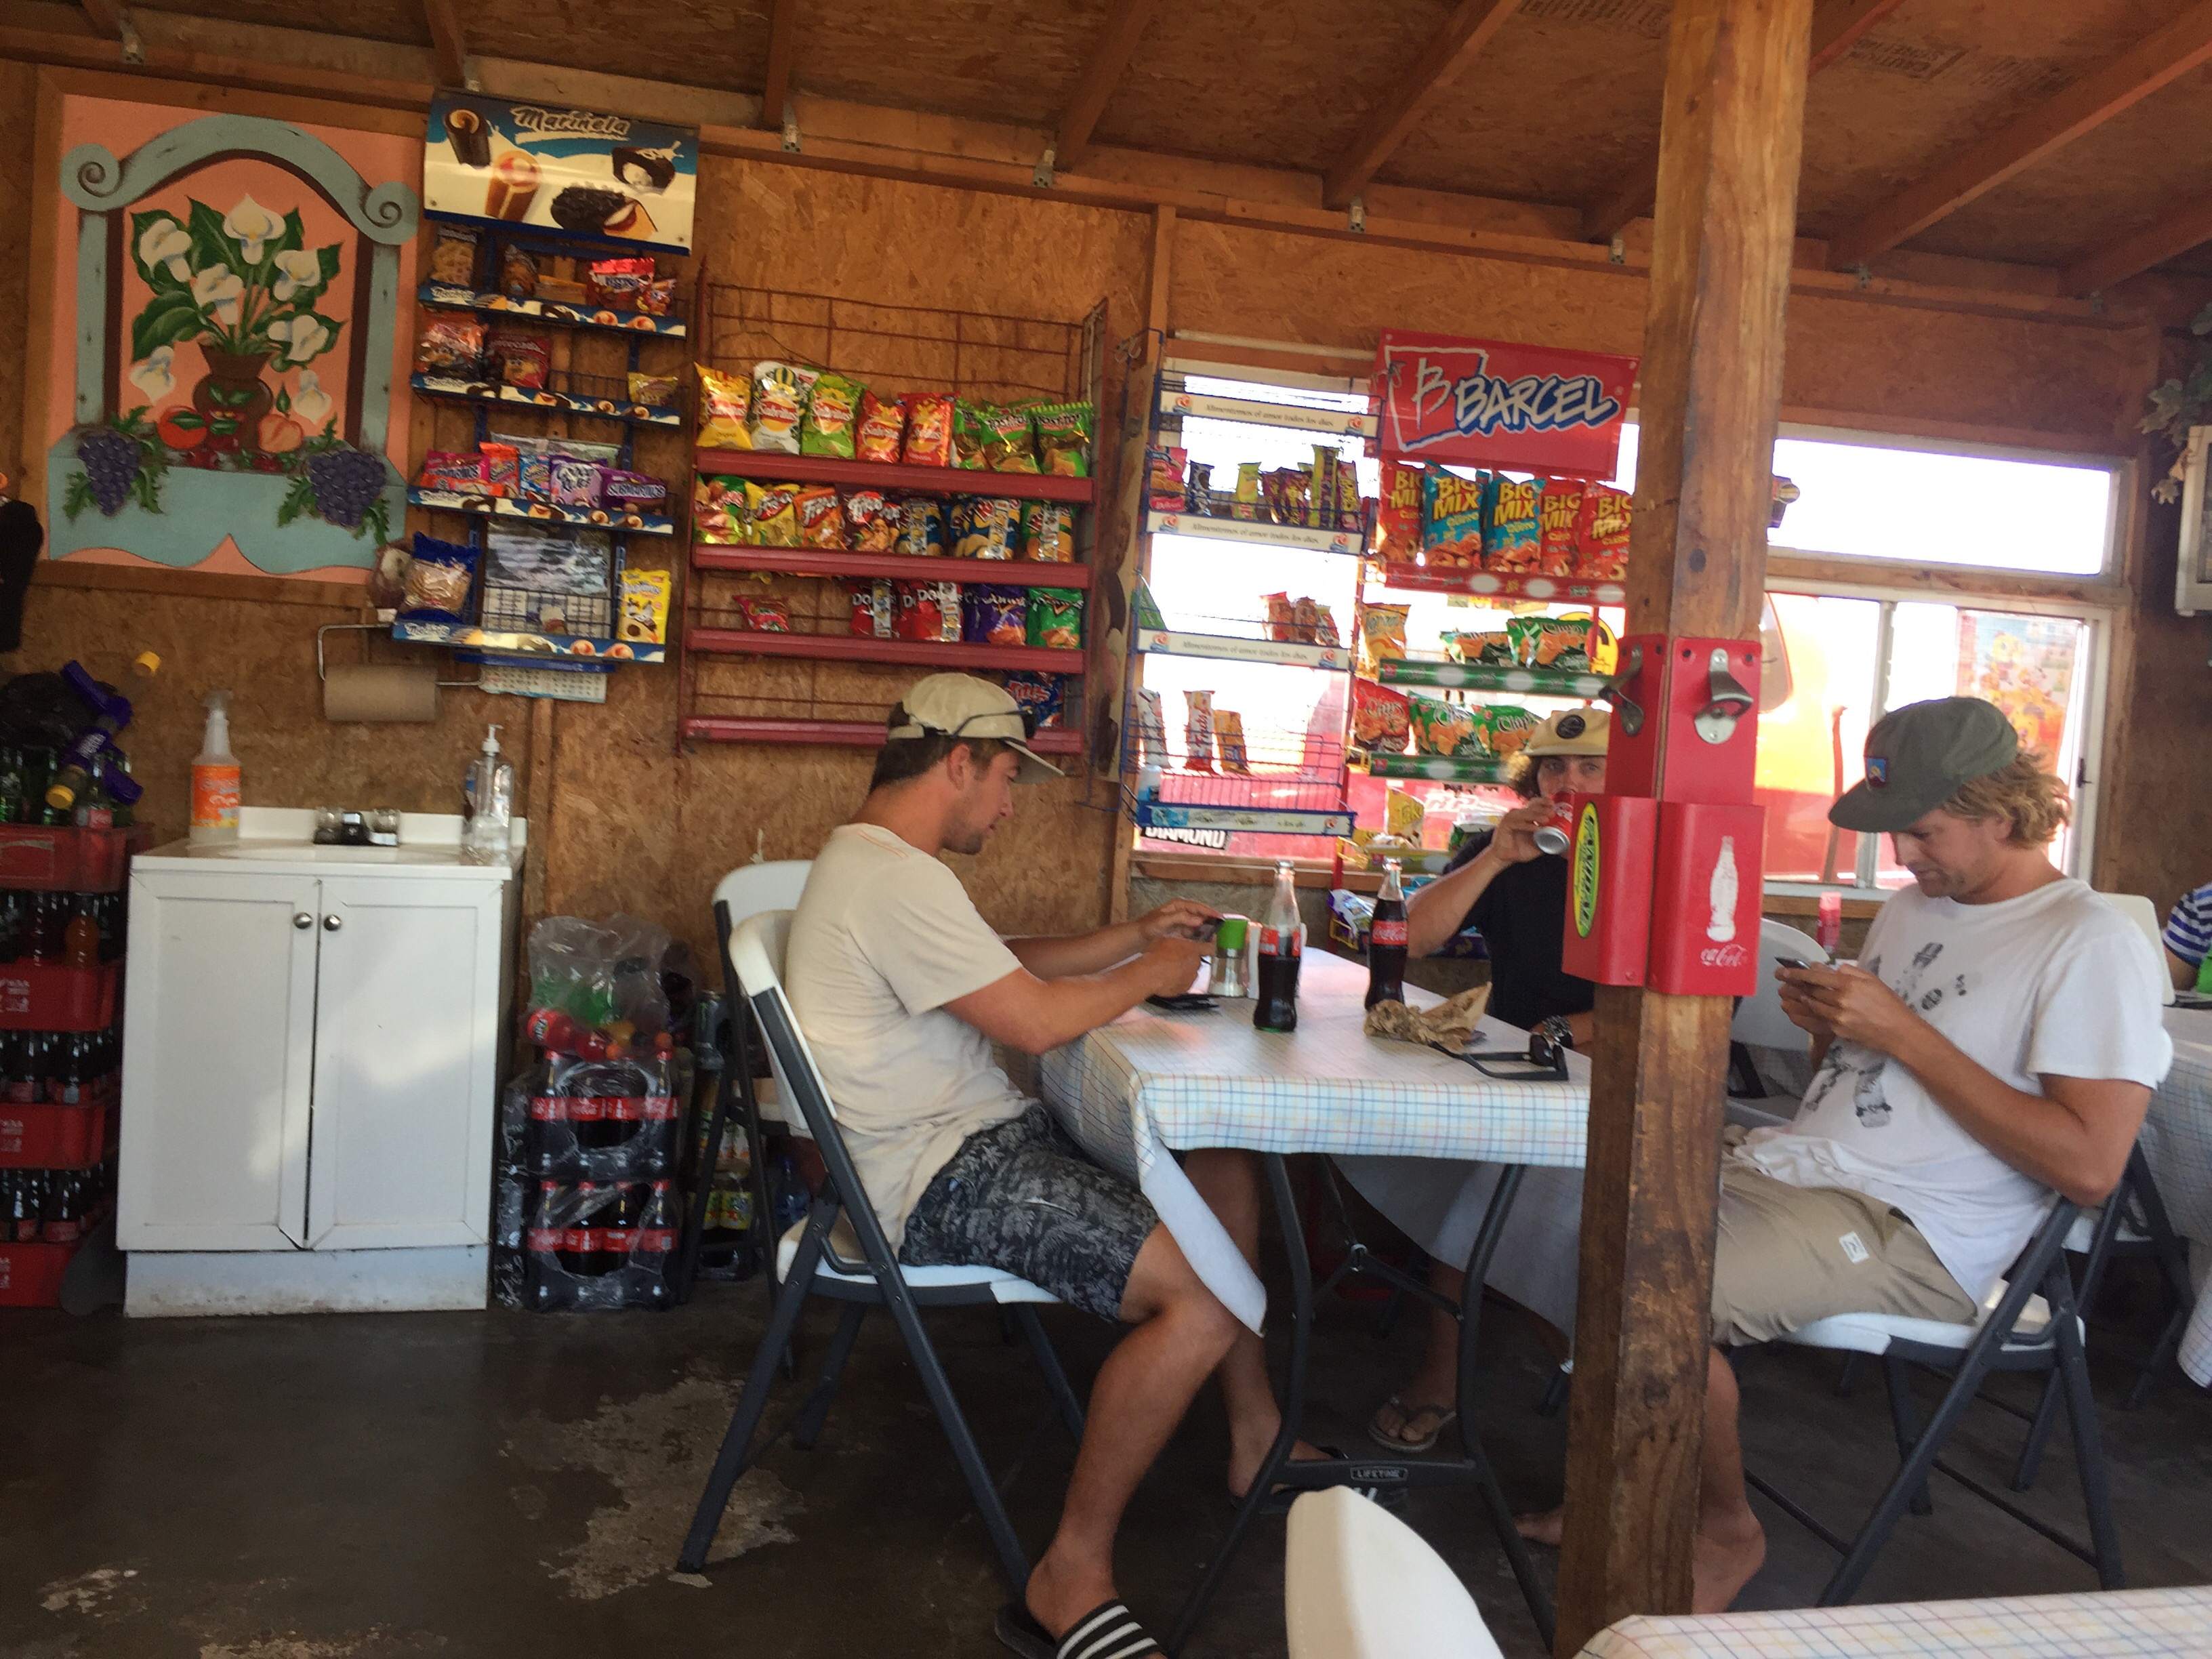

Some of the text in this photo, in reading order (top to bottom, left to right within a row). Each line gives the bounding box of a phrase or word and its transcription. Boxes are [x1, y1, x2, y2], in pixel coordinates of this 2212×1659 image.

[510, 105, 631, 136] Marinela
[1456, 375, 1620, 437] BARCEL
[1433, 490, 1481, 520] MIX
[1499, 483, 1534, 504] BIG
[1542, 493, 1583, 514] BIG
[1494, 499, 1536, 527] MIX
[1540, 510, 1579, 533] MIX
